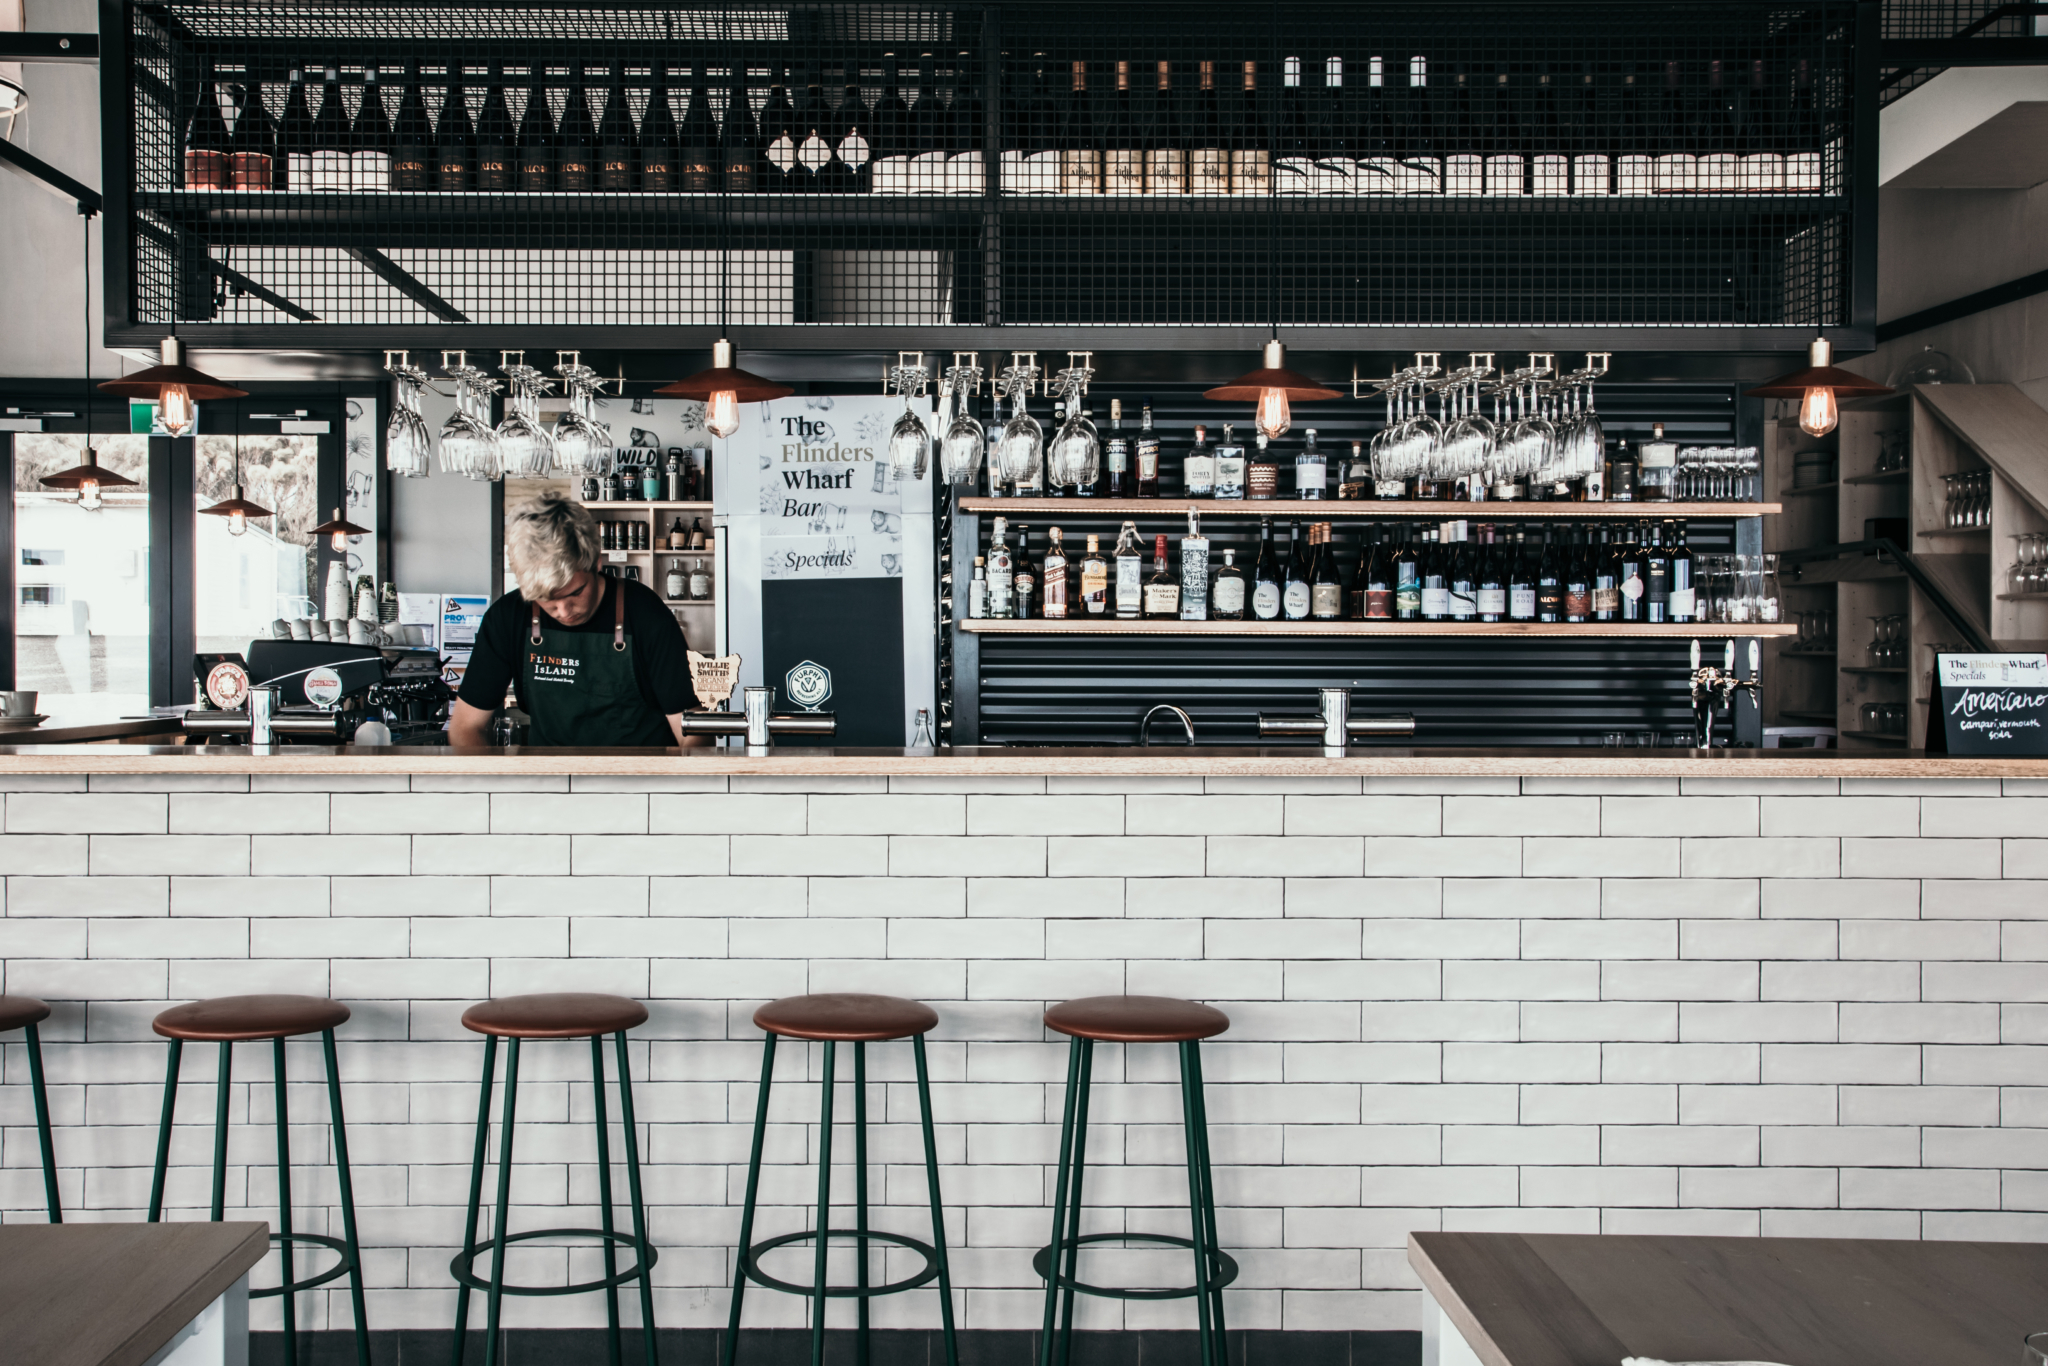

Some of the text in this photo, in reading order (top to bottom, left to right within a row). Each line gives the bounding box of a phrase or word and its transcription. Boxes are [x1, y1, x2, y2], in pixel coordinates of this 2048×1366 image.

[781, 416, 826, 436] The
[616, 448, 657, 466] WILD
[781, 442, 874, 462] Flinders
[781, 468, 855, 489] Wharf
[782, 498, 822, 517] Bar
[785, 550, 853, 571] Specials
[529, 653, 580, 667] FLINDERS
[697, 661, 730, 669] WILLIE
[1948, 660, 1968, 669] The
[2008, 660, 2039, 669] Wharf
[534, 664, 576, 676] ISLAND
[794, 669, 823, 683] FURPHY
[1950, 671, 1986, 682] Specials
[1950, 687, 2048, 717] Americano
[1989, 729, 2013, 740] soda
